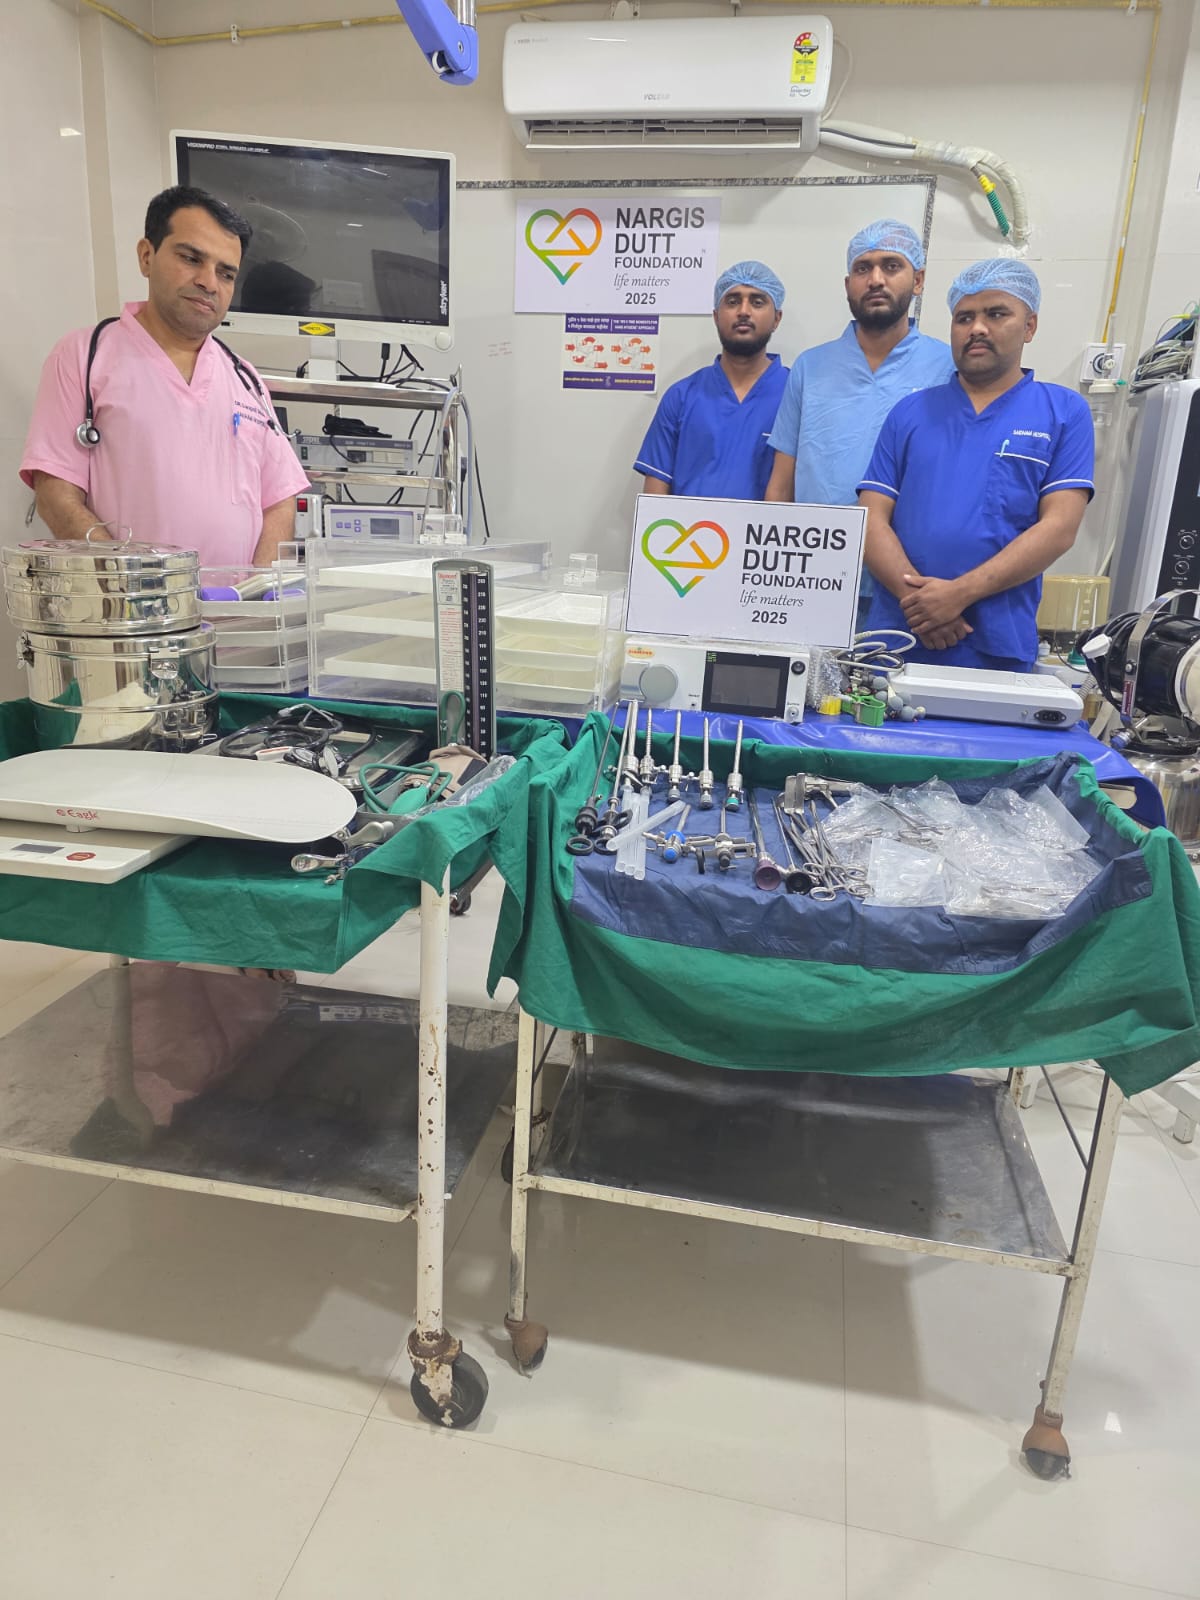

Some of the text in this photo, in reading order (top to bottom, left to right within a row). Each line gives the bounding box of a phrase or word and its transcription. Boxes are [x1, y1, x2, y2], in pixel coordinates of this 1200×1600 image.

[616, 207, 705, 229] NARGIS
[615, 233, 676, 254] DUTT
[615, 256, 703, 269] FOUNDATION
[613, 273, 670, 290] life matters
[439, 280, 448, 316] stryker
[625, 292, 656, 305] 2025
[745, 523, 847, 550] NARGIS
[743, 549, 813, 574] DUTT
[741, 573, 843, 591] FOUNDATION
[739, 589, 804, 607] life matters
[752, 610, 788, 625] 2025
